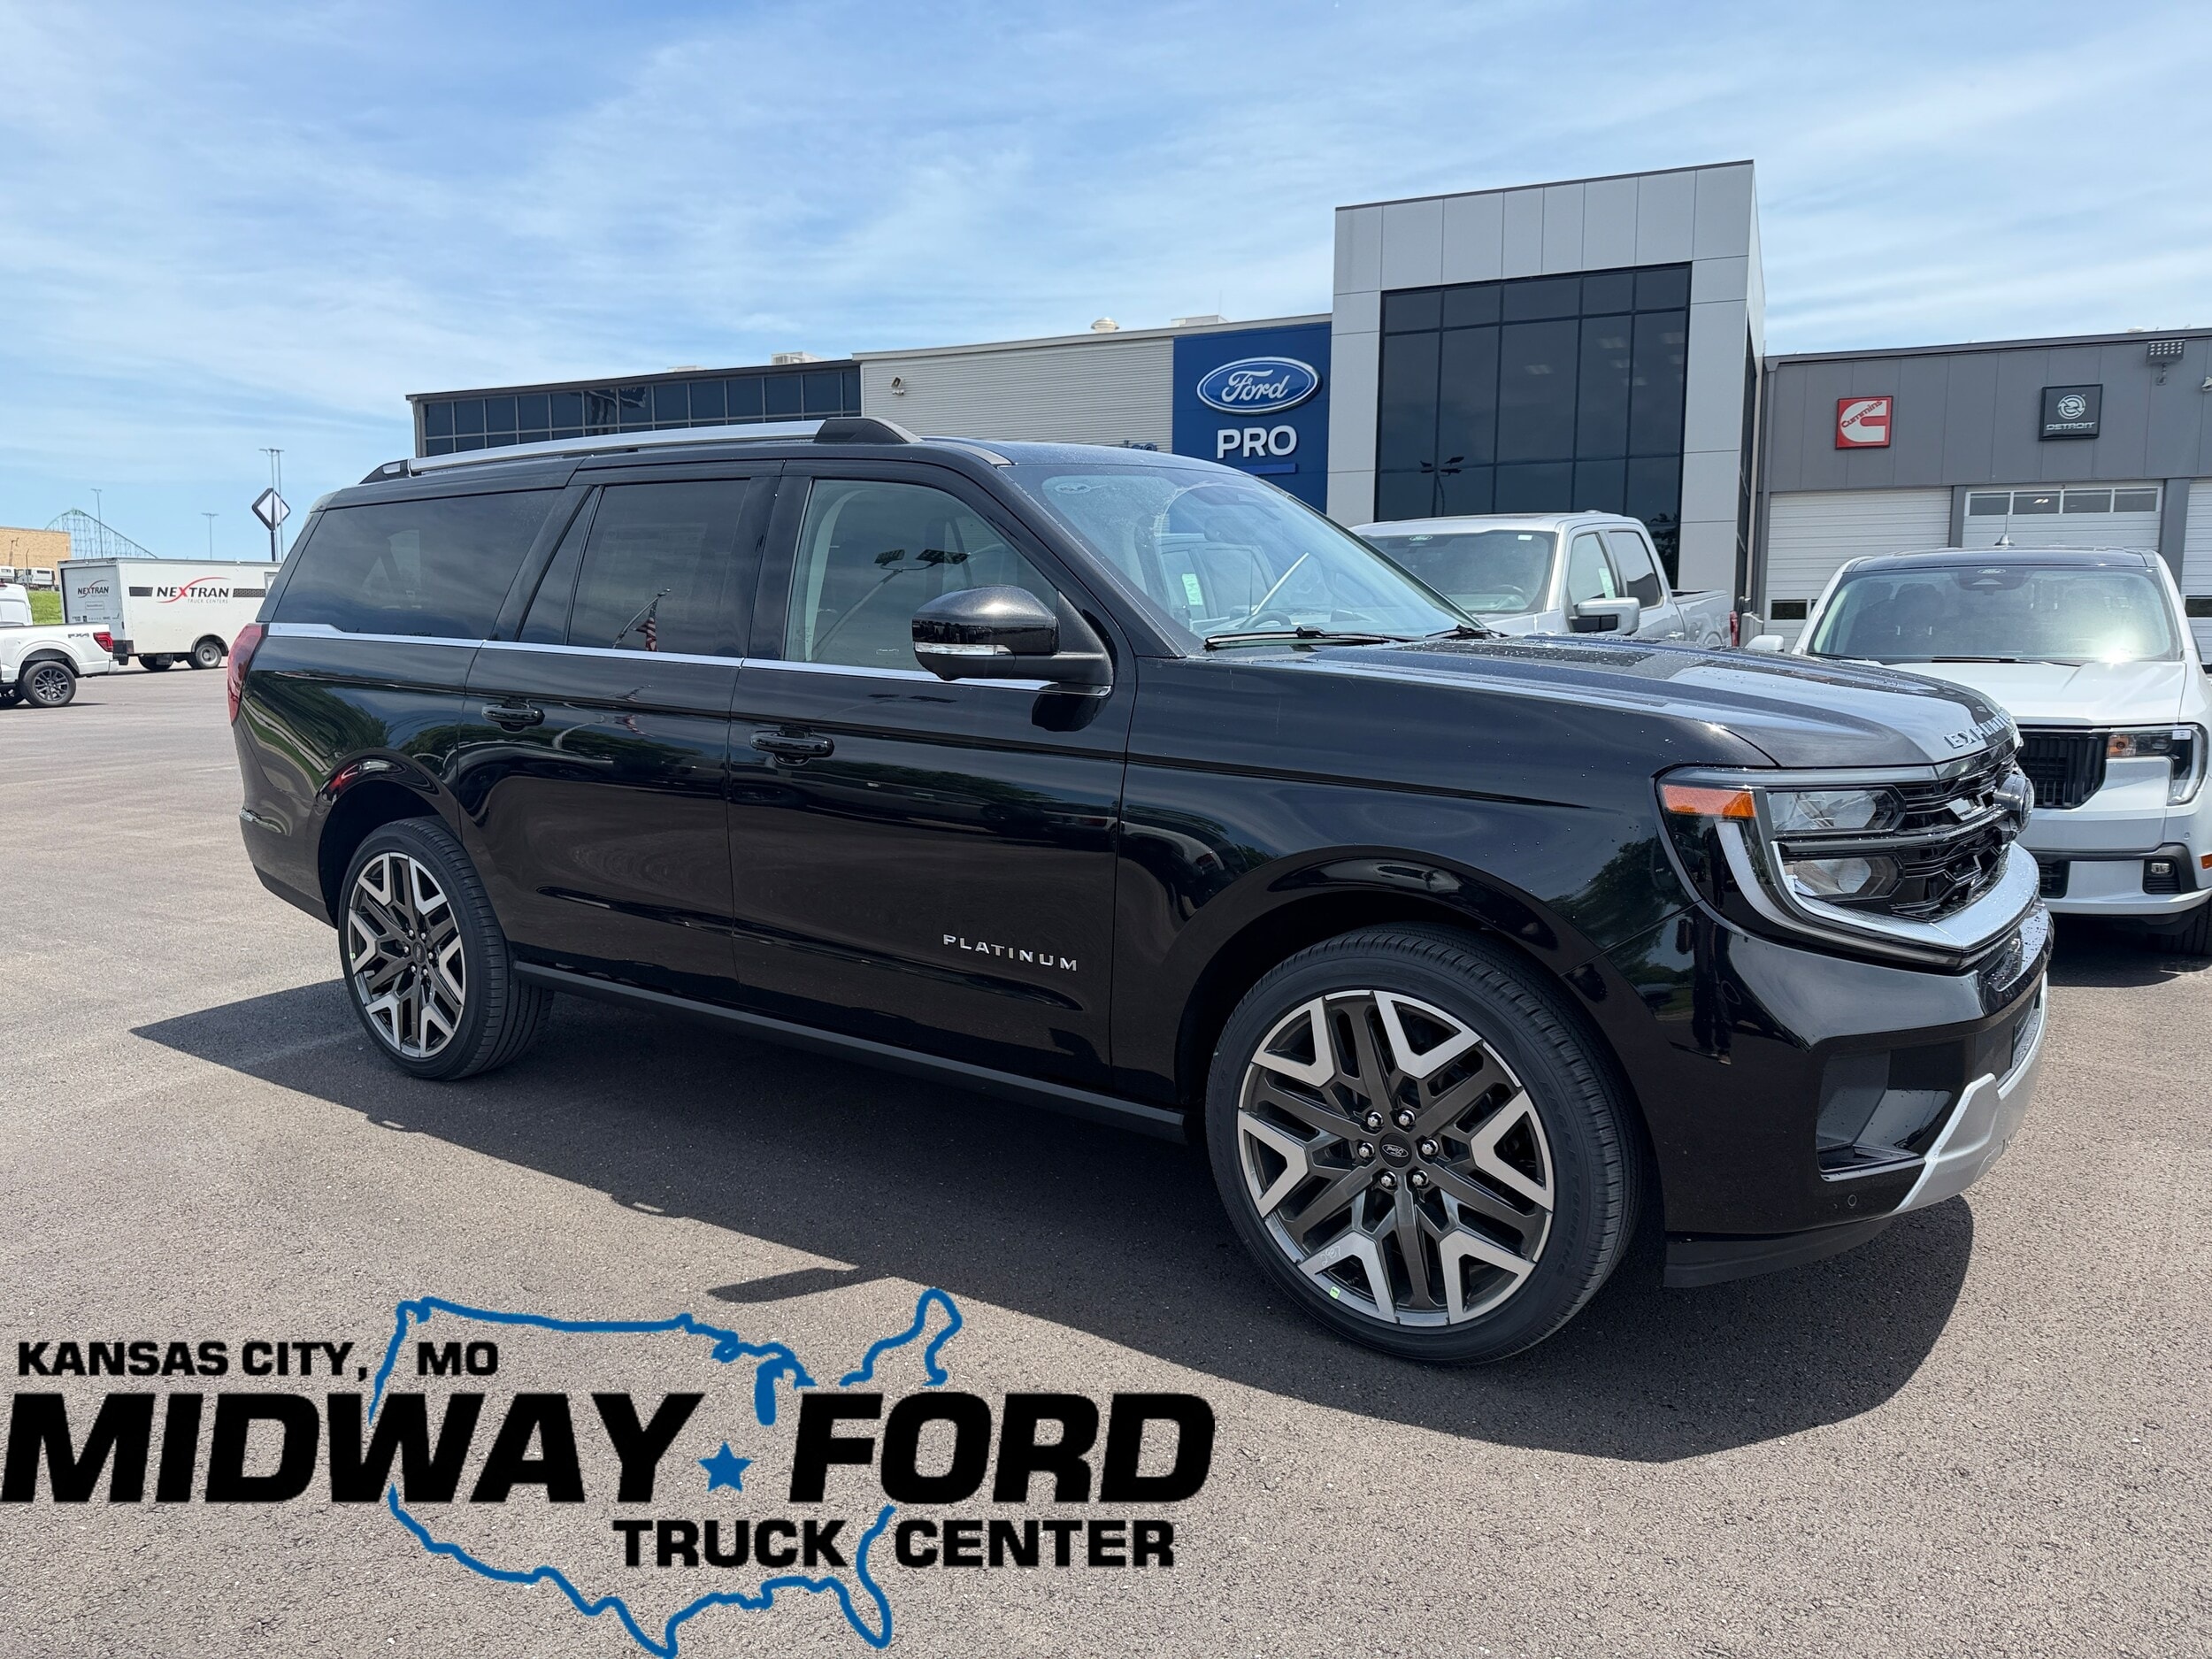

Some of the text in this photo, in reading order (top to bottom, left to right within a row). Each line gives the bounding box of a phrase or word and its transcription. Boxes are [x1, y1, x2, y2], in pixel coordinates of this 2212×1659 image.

[1221, 369, 1291, 403] Ford
[1841, 400, 1883, 427] Cummins
[2046, 422, 2095, 431] DETROIT
[1217, 425, 1298, 459] PRO
[78, 586, 109, 595] NEXTRAN
[157, 587, 229, 598] NEXTRAN
[943, 934, 1078, 972] PLATINUM
